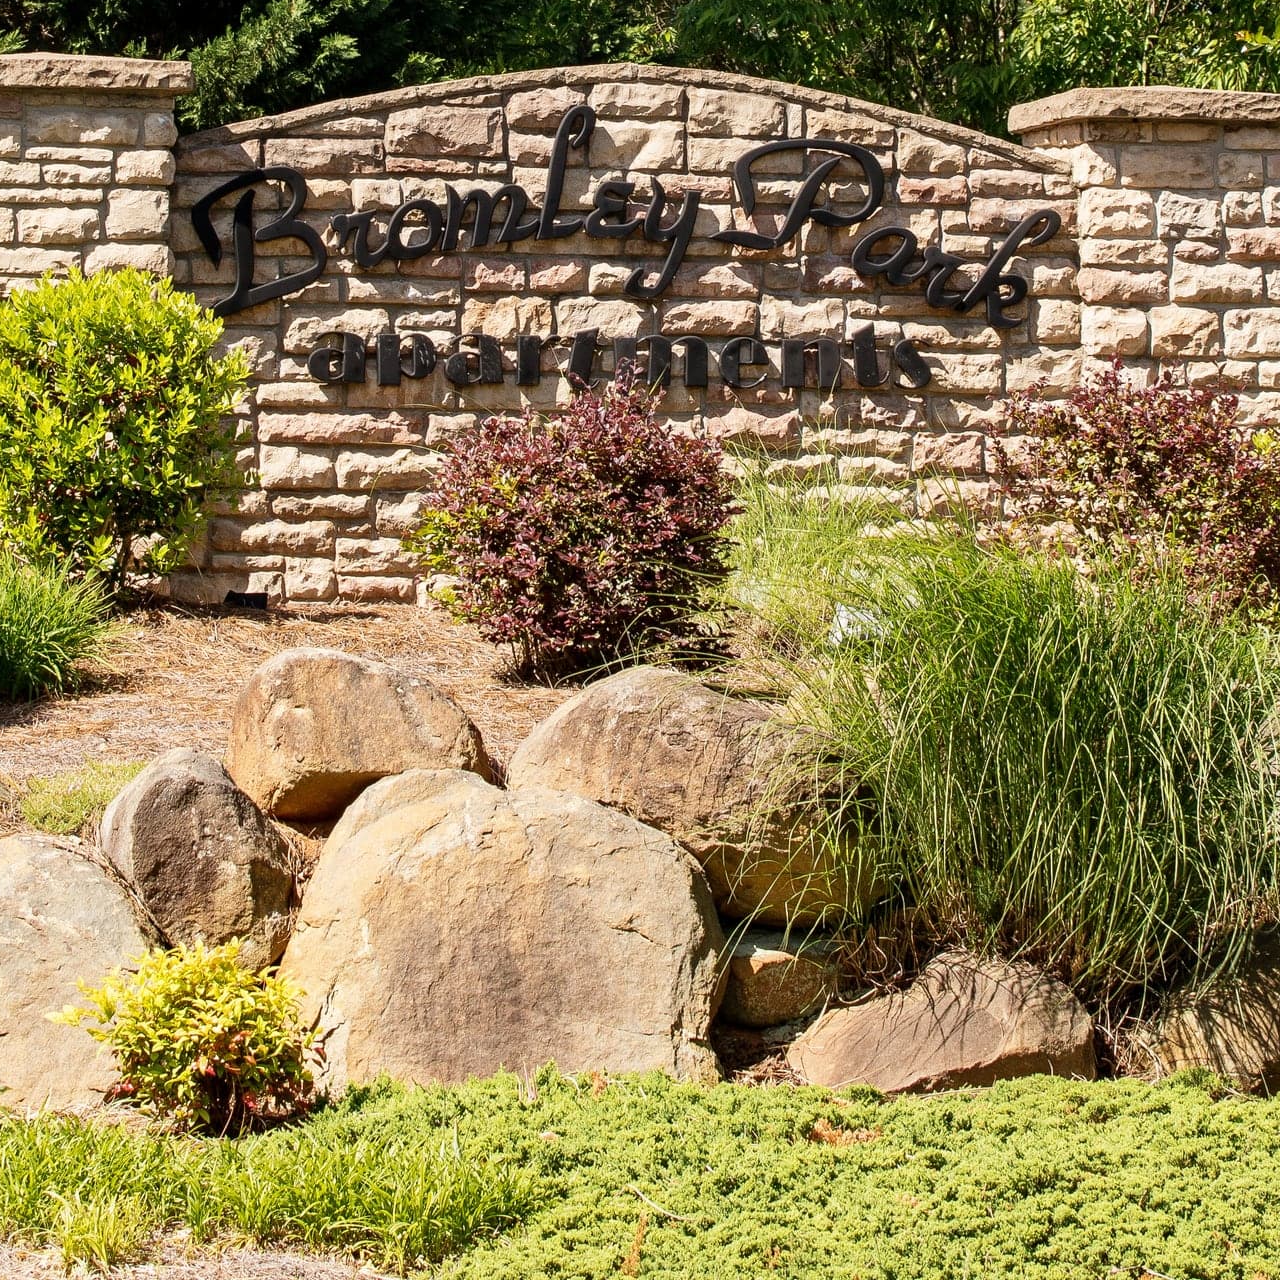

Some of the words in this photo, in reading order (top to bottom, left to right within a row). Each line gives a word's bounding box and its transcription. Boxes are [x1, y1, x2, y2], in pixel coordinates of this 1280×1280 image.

[191, 105, 701, 317] Bromley
[710, 139, 1062, 328] Park
[308, 324, 932, 389] apartments
